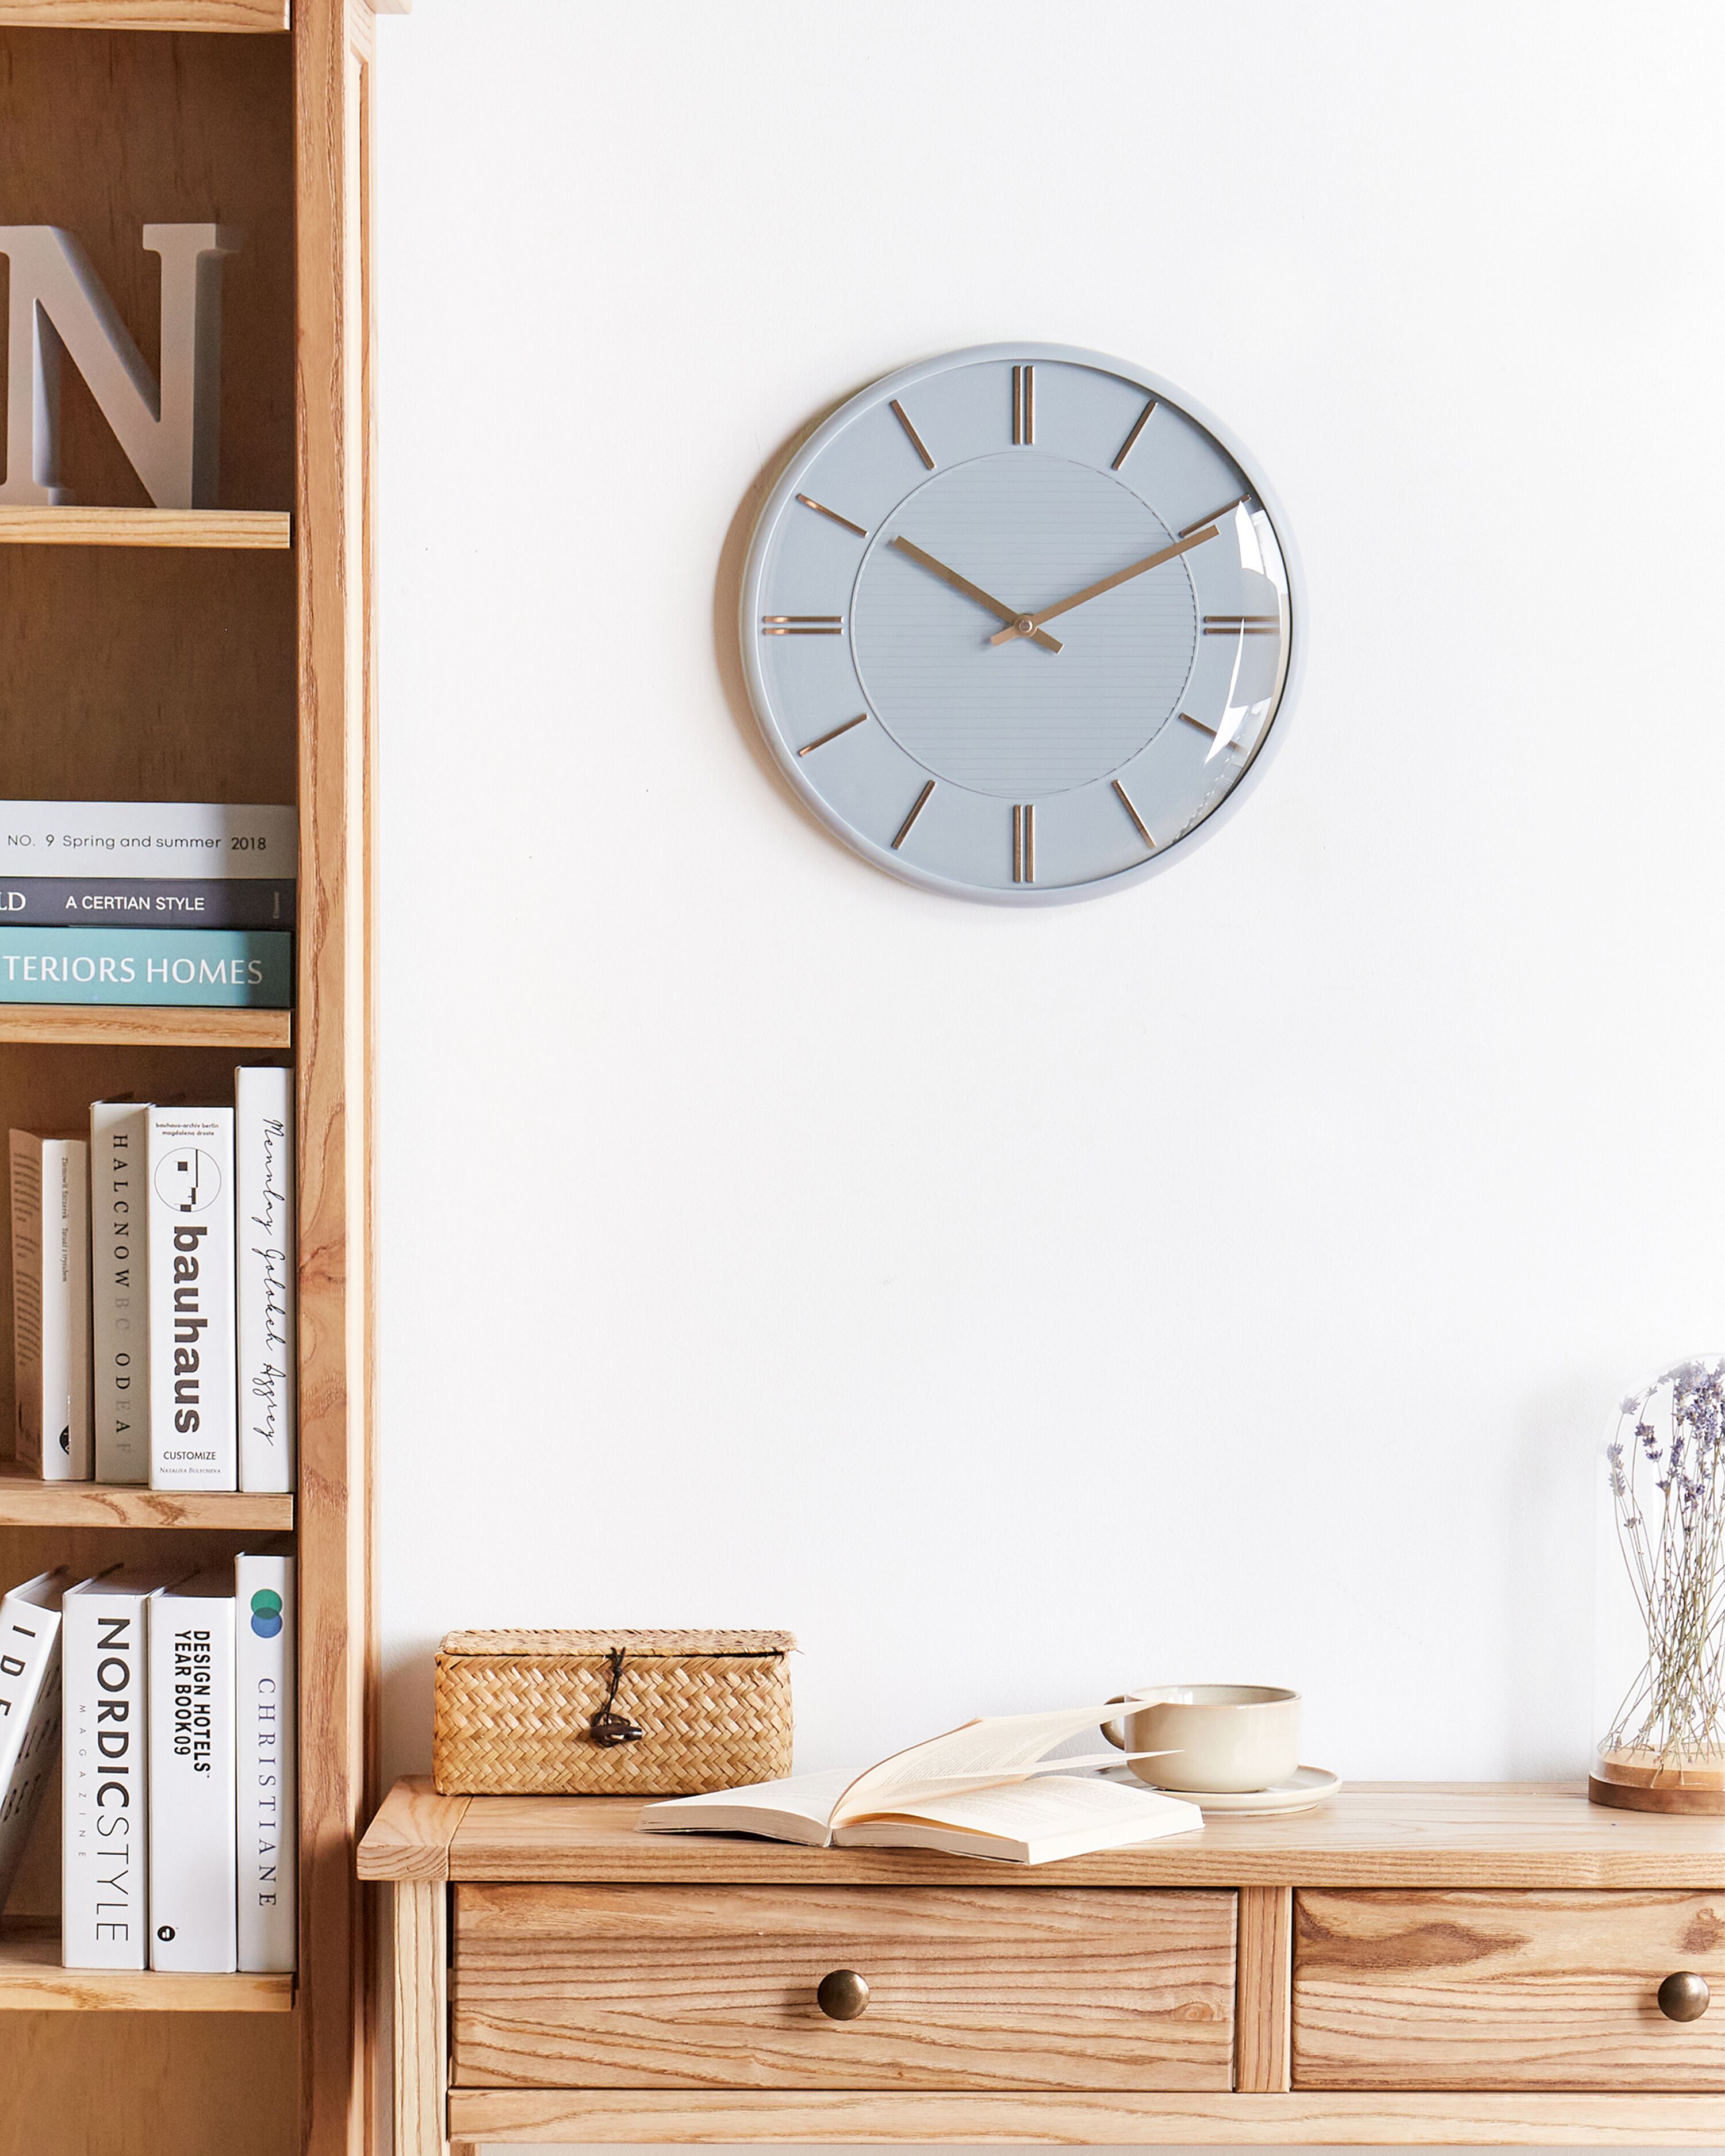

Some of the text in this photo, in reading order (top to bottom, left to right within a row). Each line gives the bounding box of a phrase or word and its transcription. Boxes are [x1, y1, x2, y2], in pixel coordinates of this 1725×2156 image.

[7, 834, 266, 851] NO. 9 Spring and summer 2018
[65, 895, 205, 911] A CERTIAN STYLE
[2, 955, 263, 985] TERIORS HOMES
[173, 1226, 208, 1433] bauhaus
[163, 1451, 216, 1460] CUSTOMIZE
[174, 1630, 191, 1677] YEAR
[193, 1631, 211, 1695] DESIGN
[78, 1704, 87, 1858] MAGAZINE
[258, 1678, 277, 1907] CHRISTIANE
